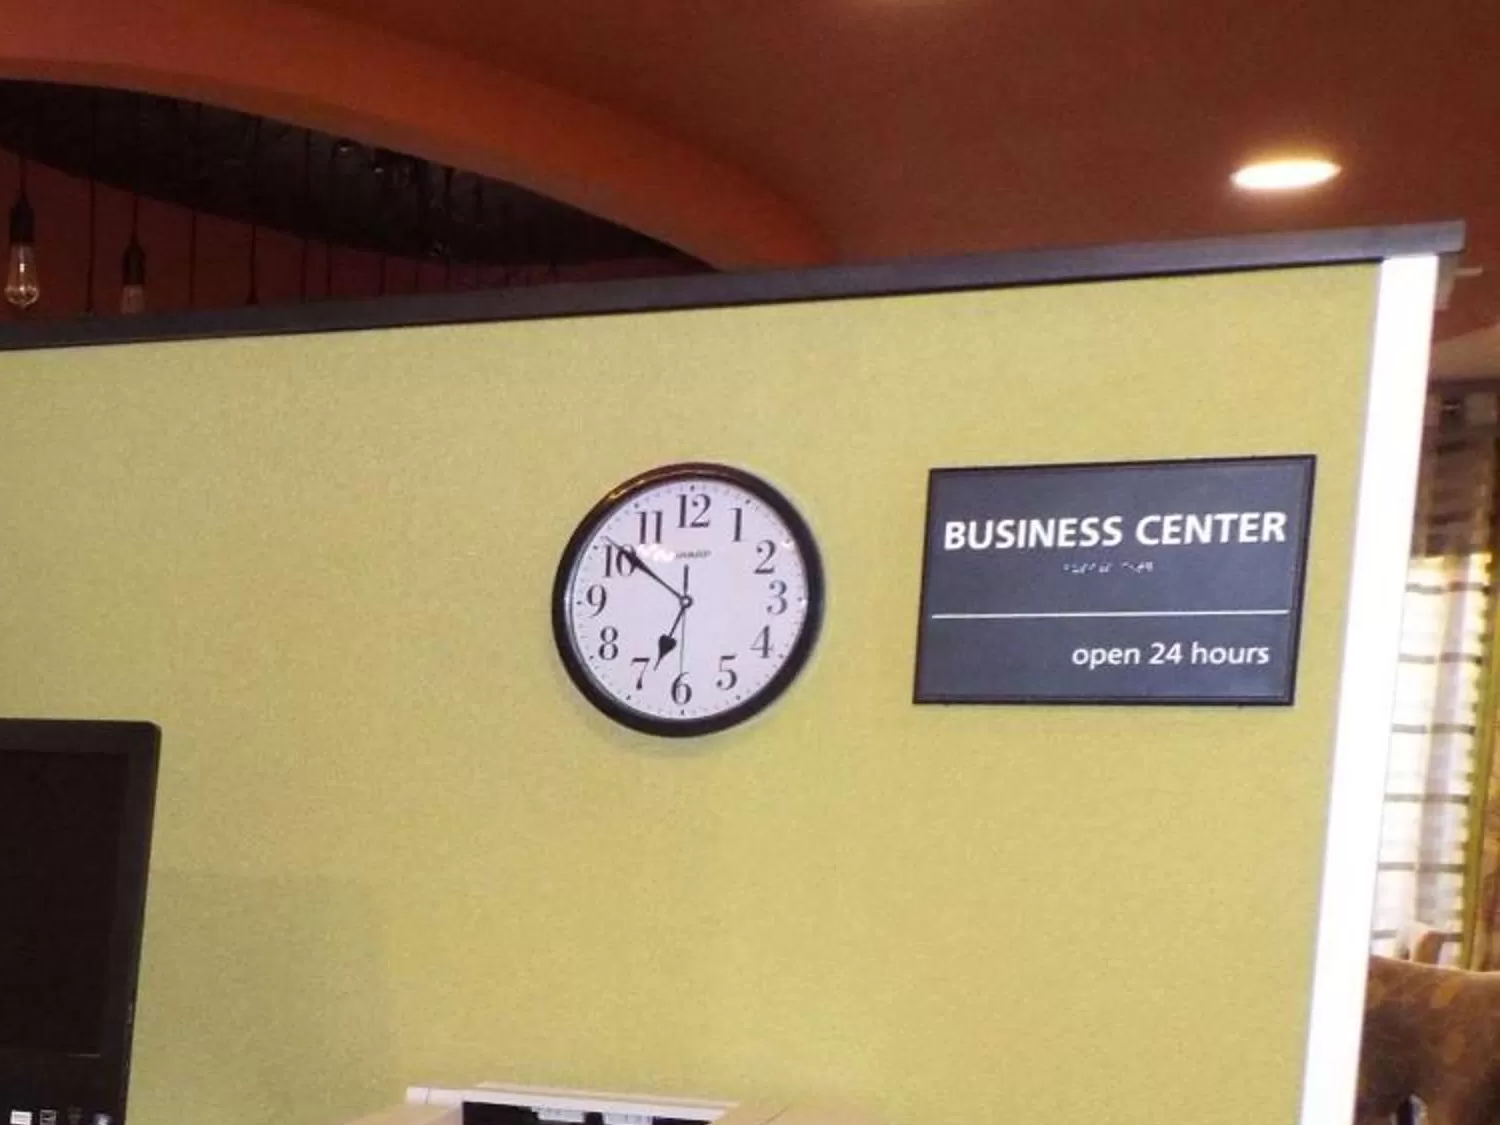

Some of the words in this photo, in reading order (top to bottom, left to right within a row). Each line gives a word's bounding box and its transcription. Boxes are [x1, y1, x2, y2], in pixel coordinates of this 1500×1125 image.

[636, 510, 664, 544] 11
[676, 493, 712, 528] 12
[730, 507, 743, 542] 1
[944, 516, 1123, 550] BUSINESS
[1136, 512, 1287, 546] CENTER
[601, 544, 636, 578] 10
[754, 540, 777, 574] 2
[587, 584, 607, 617] 9
[766, 580, 788, 615] 3
[598, 626, 619, 660] 8
[750, 625, 774, 659] 4
[1072, 646, 1141, 670] open
[1148, 642, 1183, 665] 24
[1191, 641, 1270, 666] hours
[630, 657, 651, 690] 7
[671, 671, 693, 705] 6
[716, 655, 737, 690] 5
